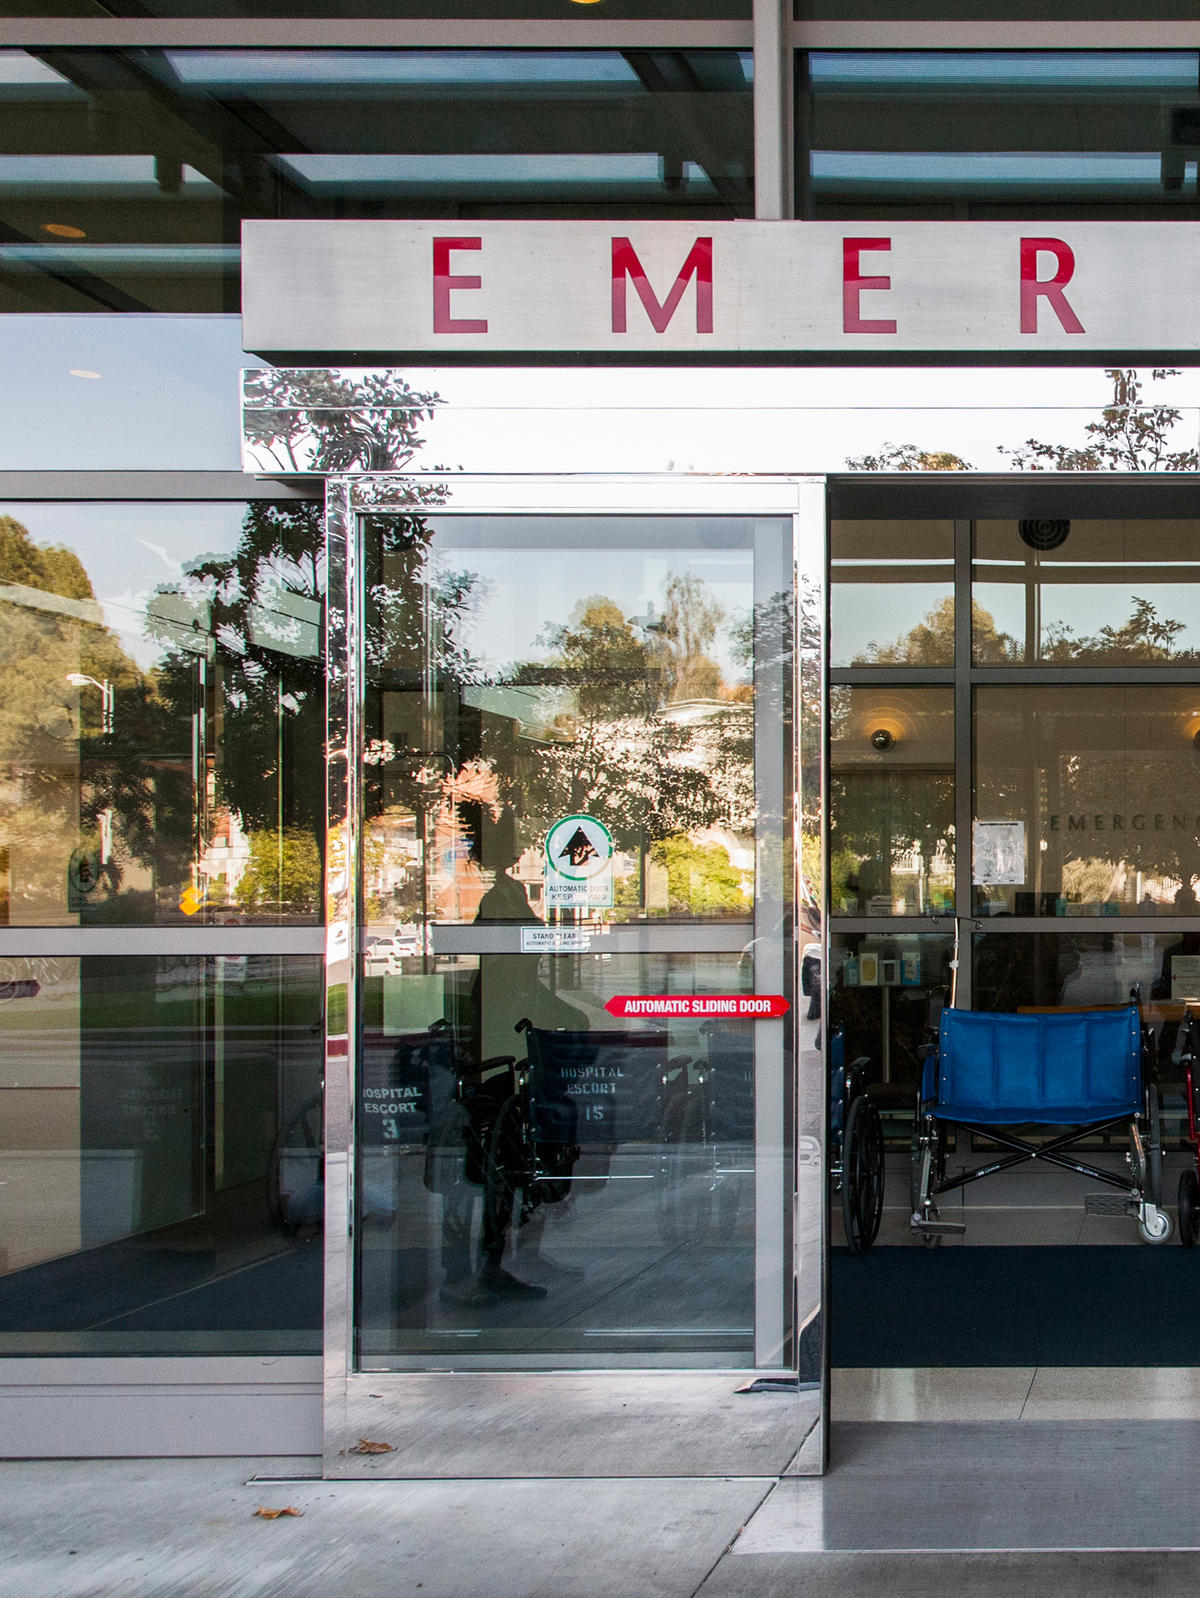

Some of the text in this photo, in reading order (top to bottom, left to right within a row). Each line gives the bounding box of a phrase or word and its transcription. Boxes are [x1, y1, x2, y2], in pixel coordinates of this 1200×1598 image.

[624, 1000, 771, 1013] AUTOMATIC SLIDING DOOR
[561, 1066, 624, 1078] HOSPITAL
[567, 1082, 617, 1094] ESCORT
[364, 1102, 417, 1114] ESCORT
[586, 1105, 604, 1120] 15
[382, 1118, 400, 1139] 3
